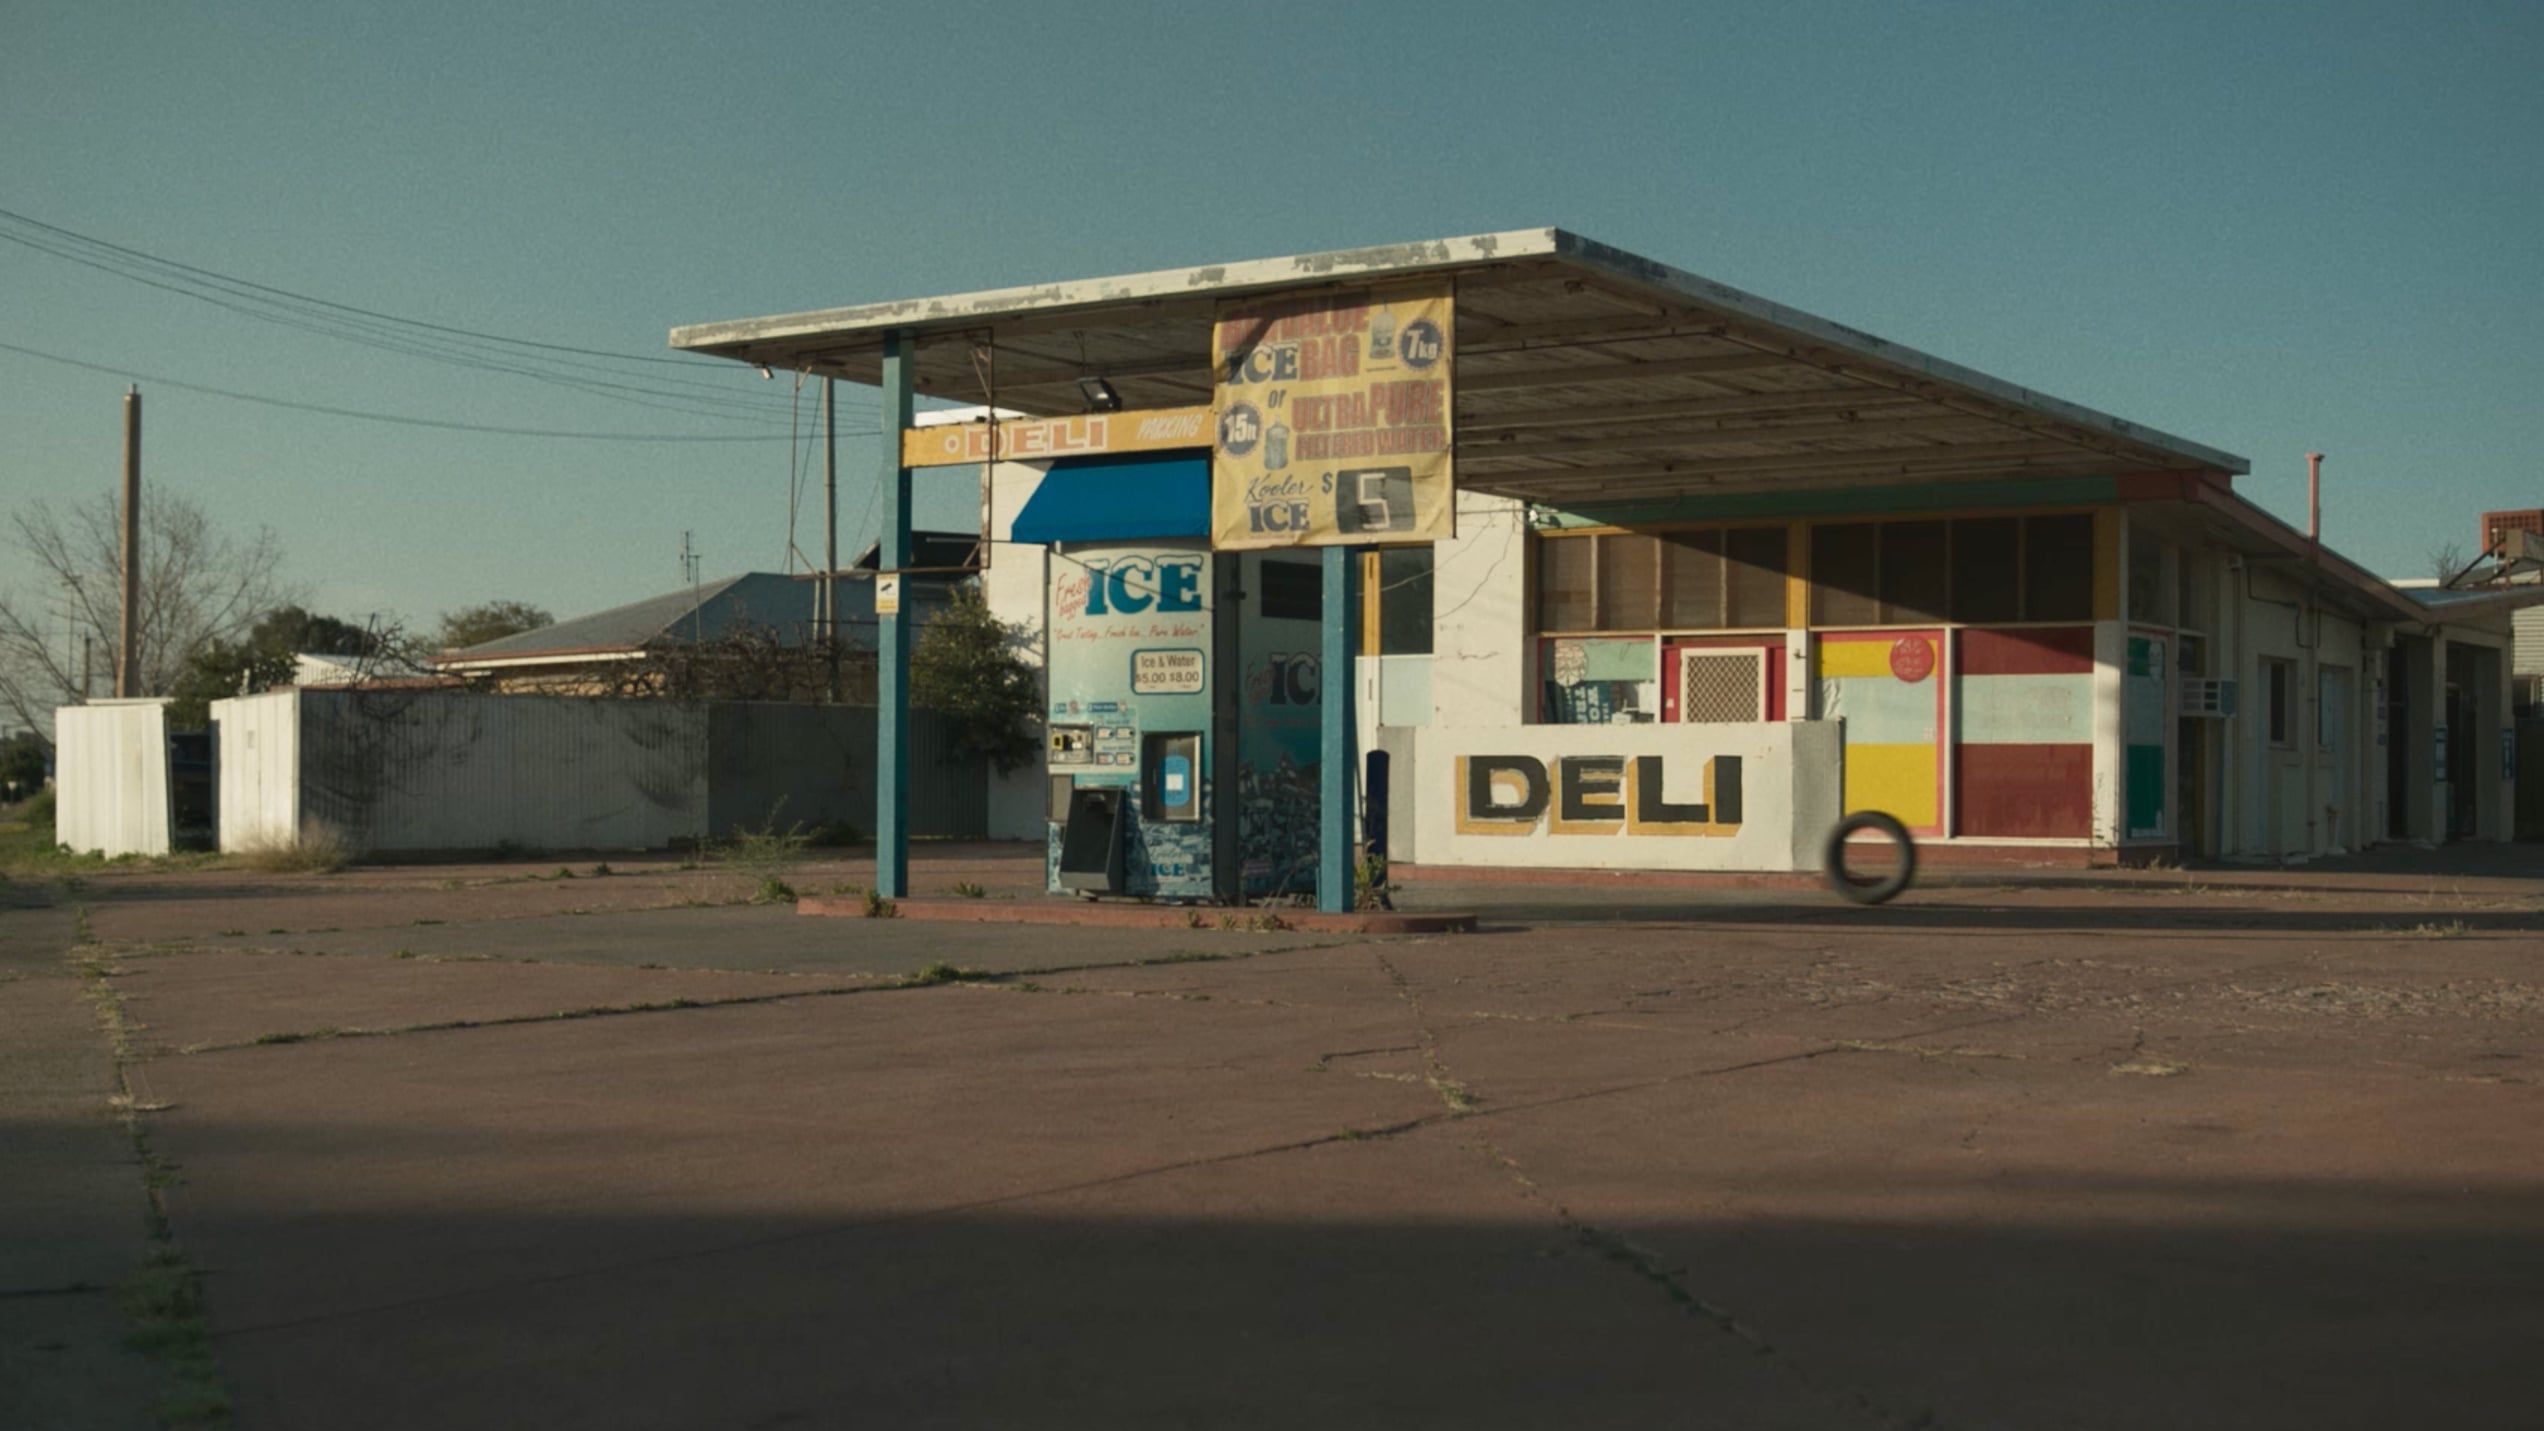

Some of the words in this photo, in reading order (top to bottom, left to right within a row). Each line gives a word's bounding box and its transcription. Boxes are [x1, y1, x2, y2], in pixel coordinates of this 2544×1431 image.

[1227, 342, 1299, 386] ICE
[1300, 334, 1360, 382] BAG
[1268, 389, 1287, 409] or
[966, 415, 1109, 460] DELI
[1377, 425, 1446, 455] WATER
[1244, 472, 1313, 505] Kooler
[1321, 471, 1333, 494] $
[1357, 472, 1392, 530] 5
[1247, 497, 1311, 533] ICE
[1085, 554, 1204, 615] ICE
[1141, 655, 1156, 668] Ice
[1158, 655, 1165, 668] &
[1167, 654, 1196, 667] Water
[1270, 651, 1322, 705] IC
[1455, 755, 1743, 837] DELI
